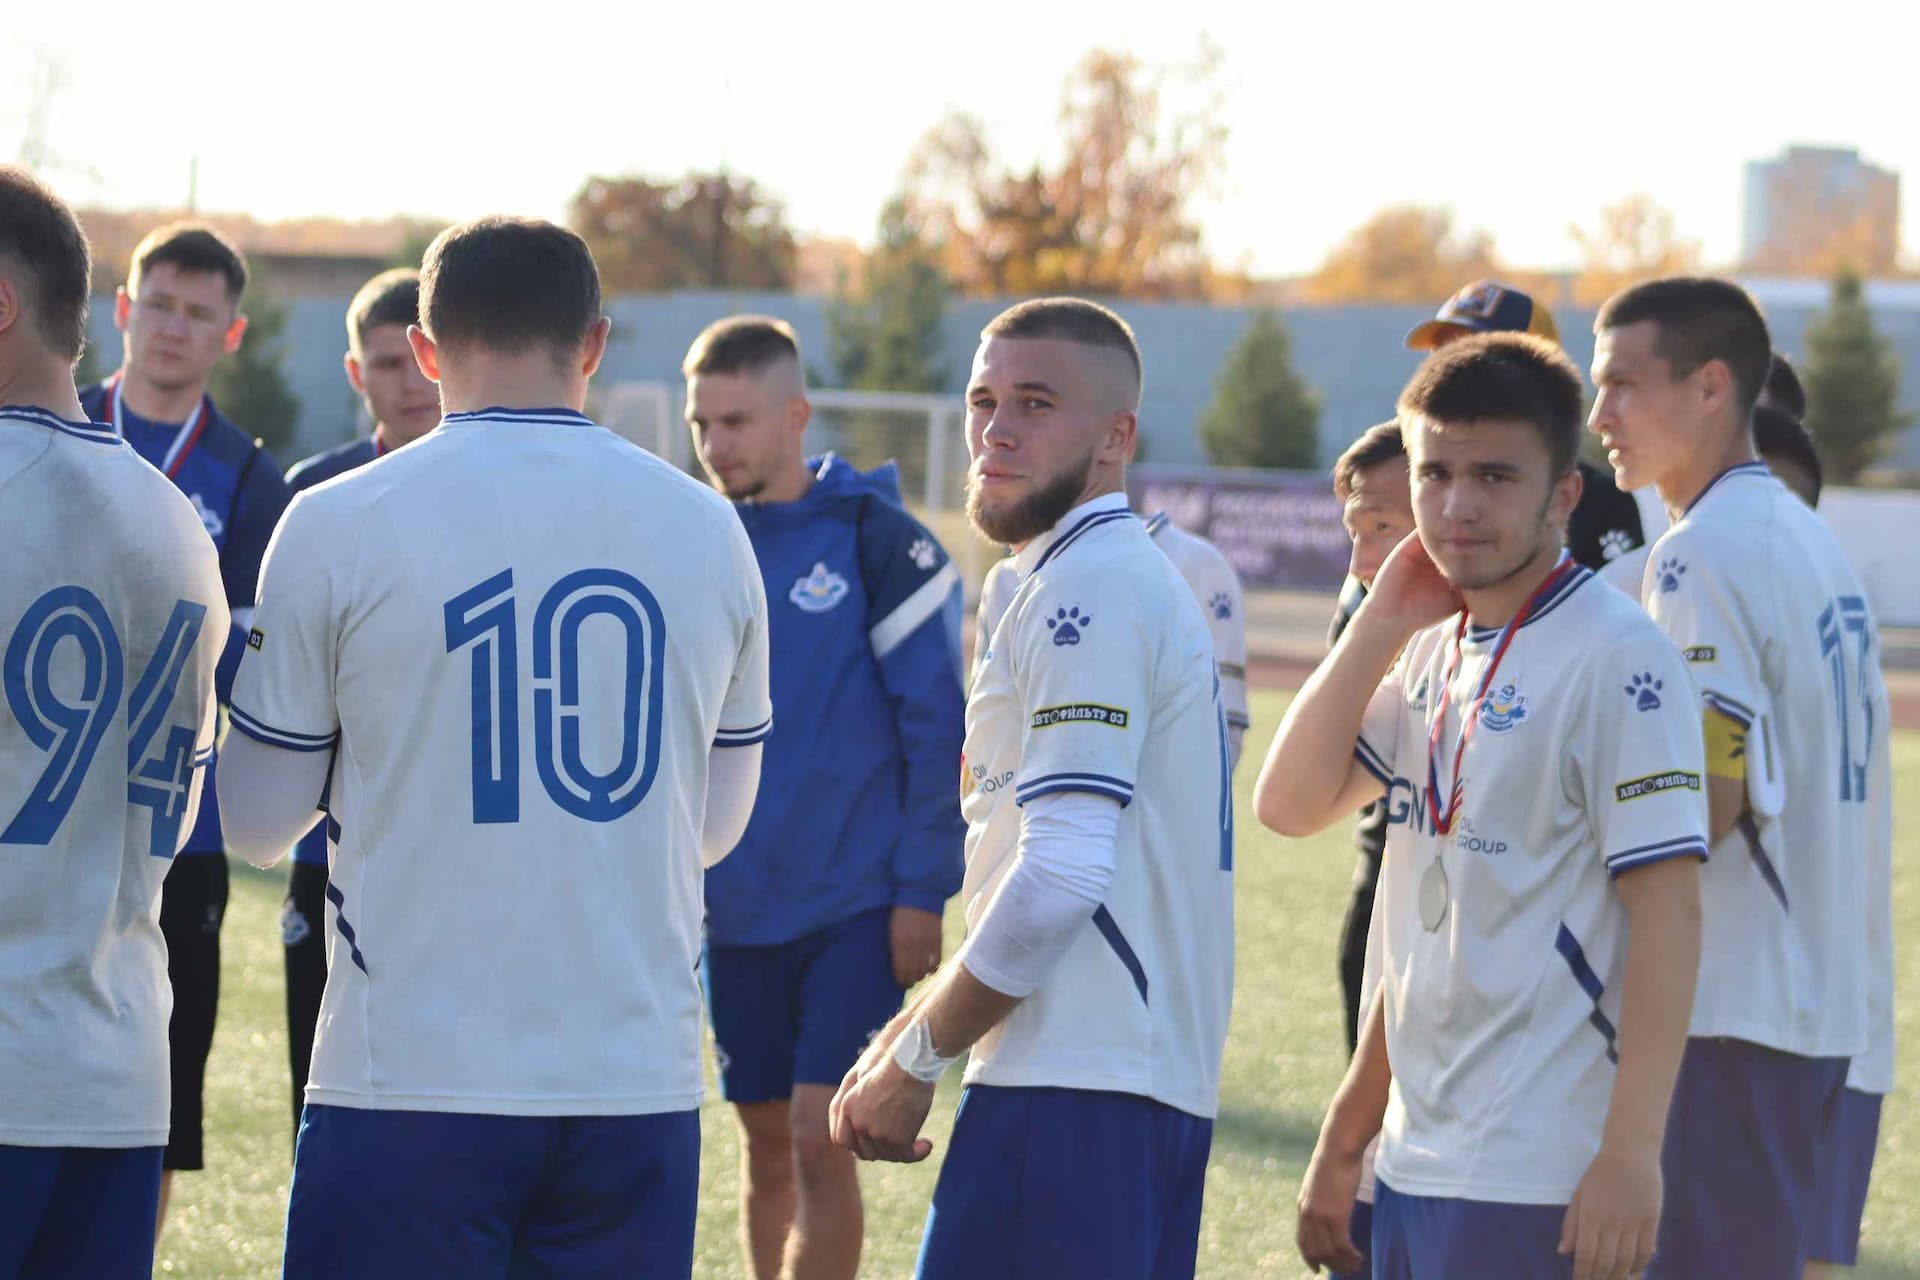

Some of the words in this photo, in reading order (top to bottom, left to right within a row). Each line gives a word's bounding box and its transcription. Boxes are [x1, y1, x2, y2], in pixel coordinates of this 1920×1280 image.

[0, 585, 208, 859] 94
[443, 566, 666, 824] 10
[1109, 712, 1126, 725] 03
[979, 770, 1014, 794] OUP
